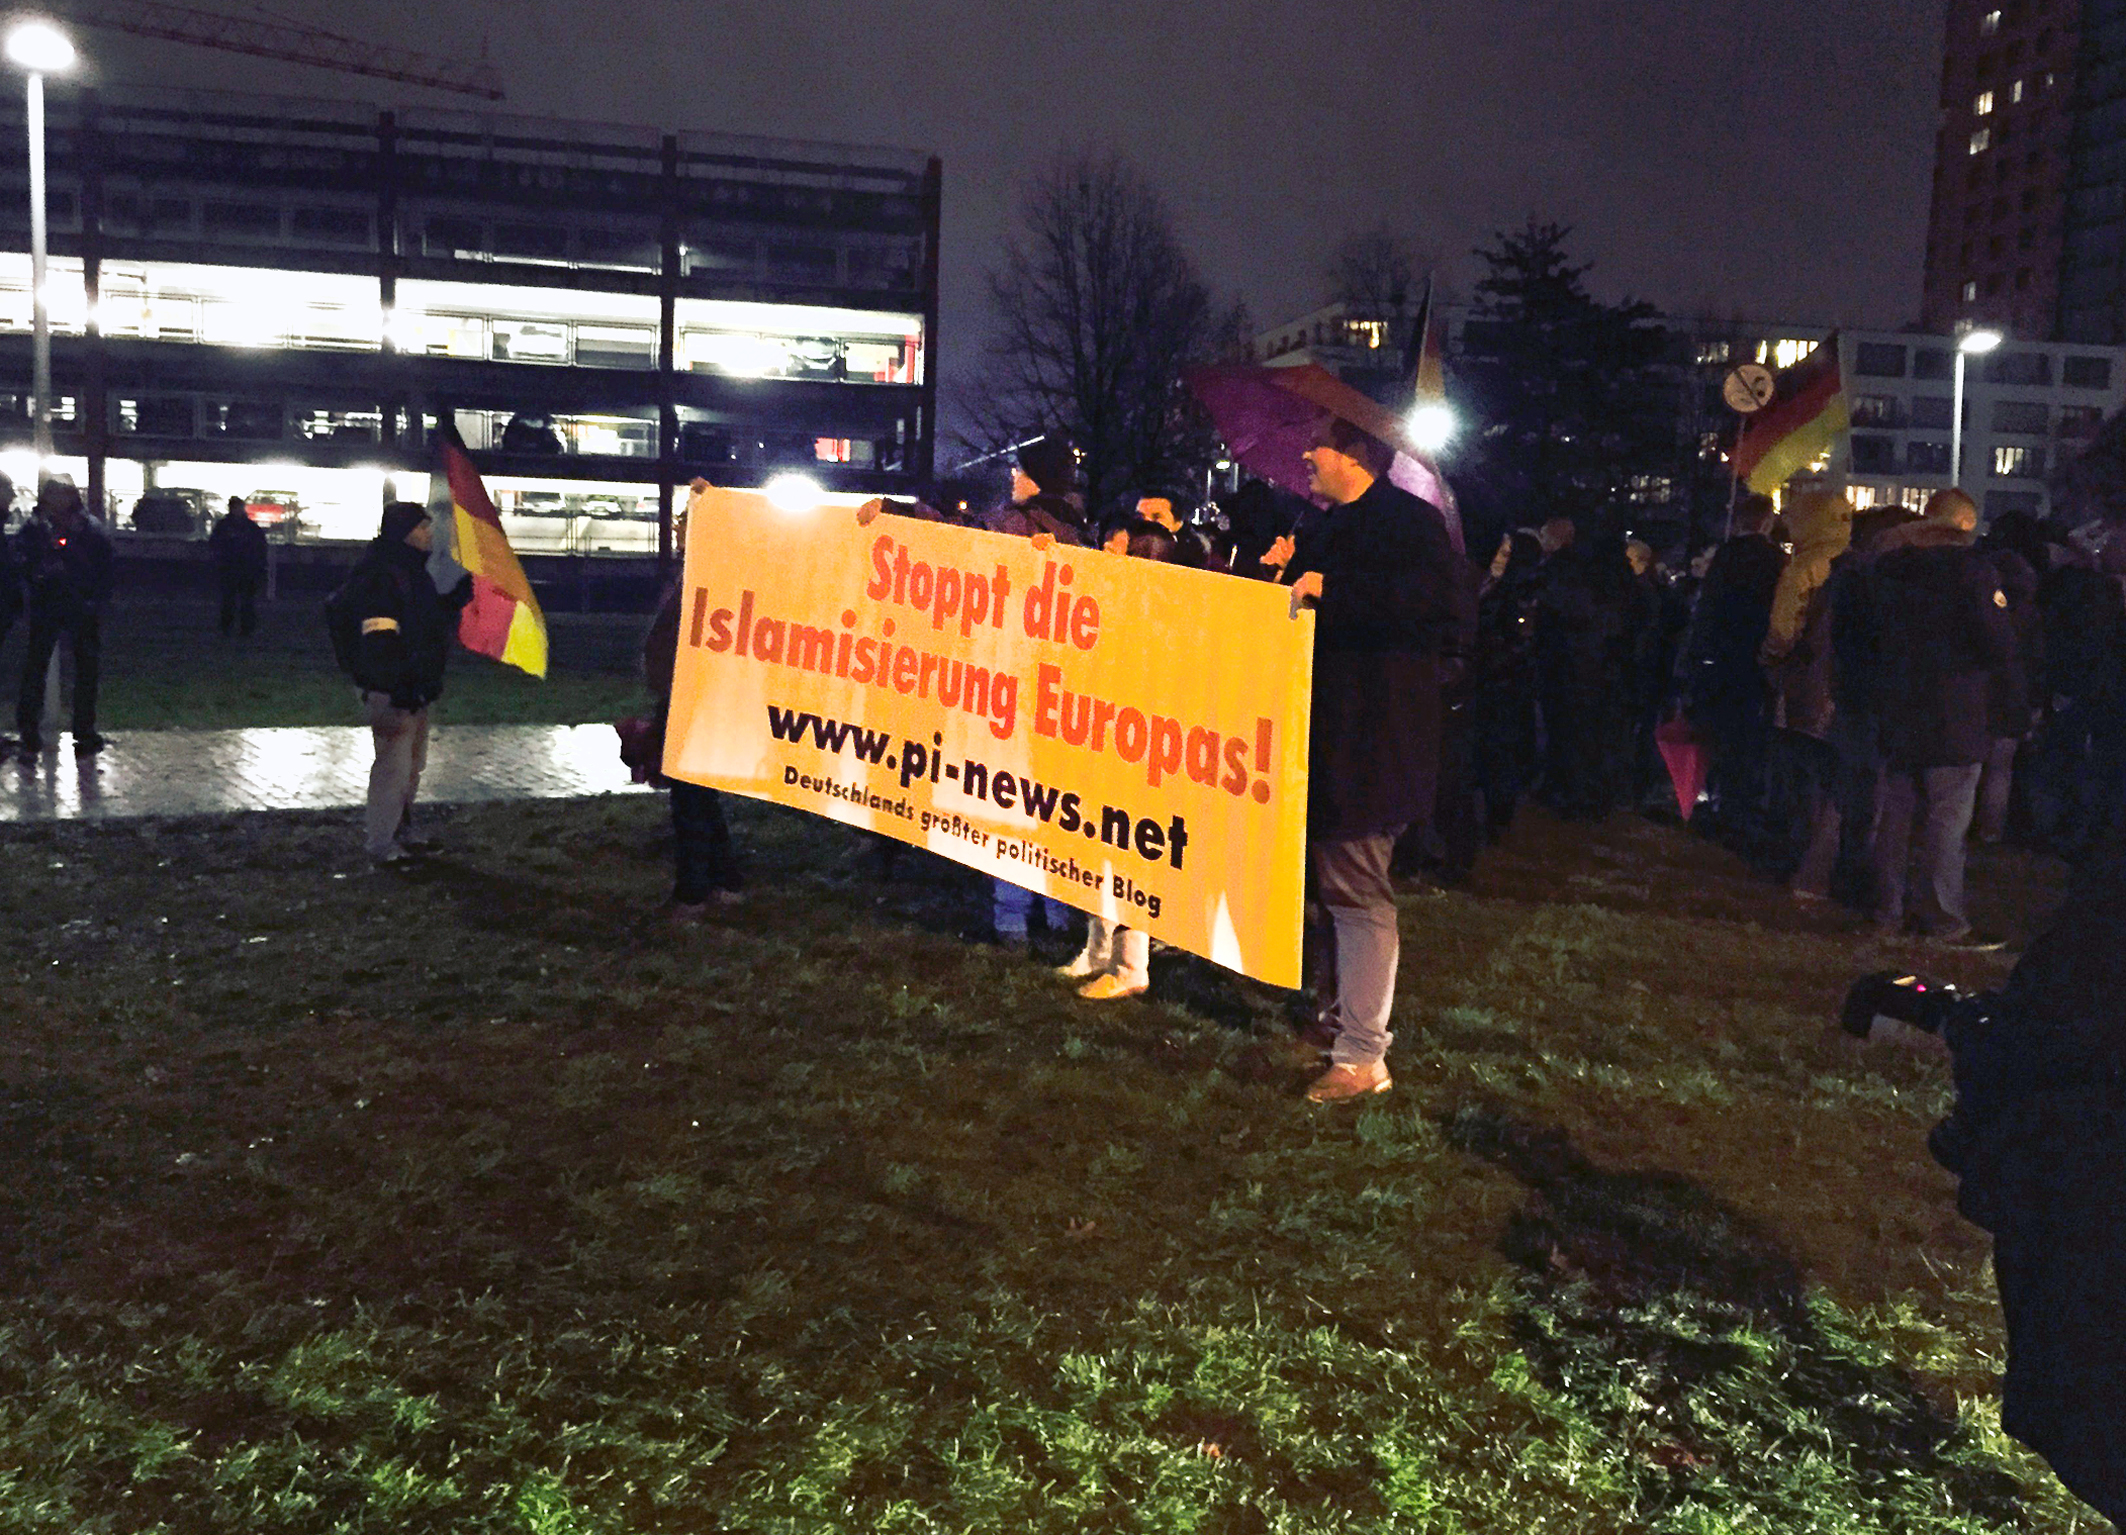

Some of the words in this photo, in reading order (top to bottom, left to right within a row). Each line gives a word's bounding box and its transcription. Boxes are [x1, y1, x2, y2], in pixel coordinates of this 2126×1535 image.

[867, 535, 1010, 637] Stoppt
[1024, 559, 1100, 650] die
[689, 587, 1017, 739] Islamisierung
[1034, 663, 1273, 804] Europas!
[767, 705, 1188, 870] www.pi-news.net
[784, 766, 914, 820] Deutschlands
[997, 838, 1104, 890] politischer
[1112, 876, 1162, 918] Blog
